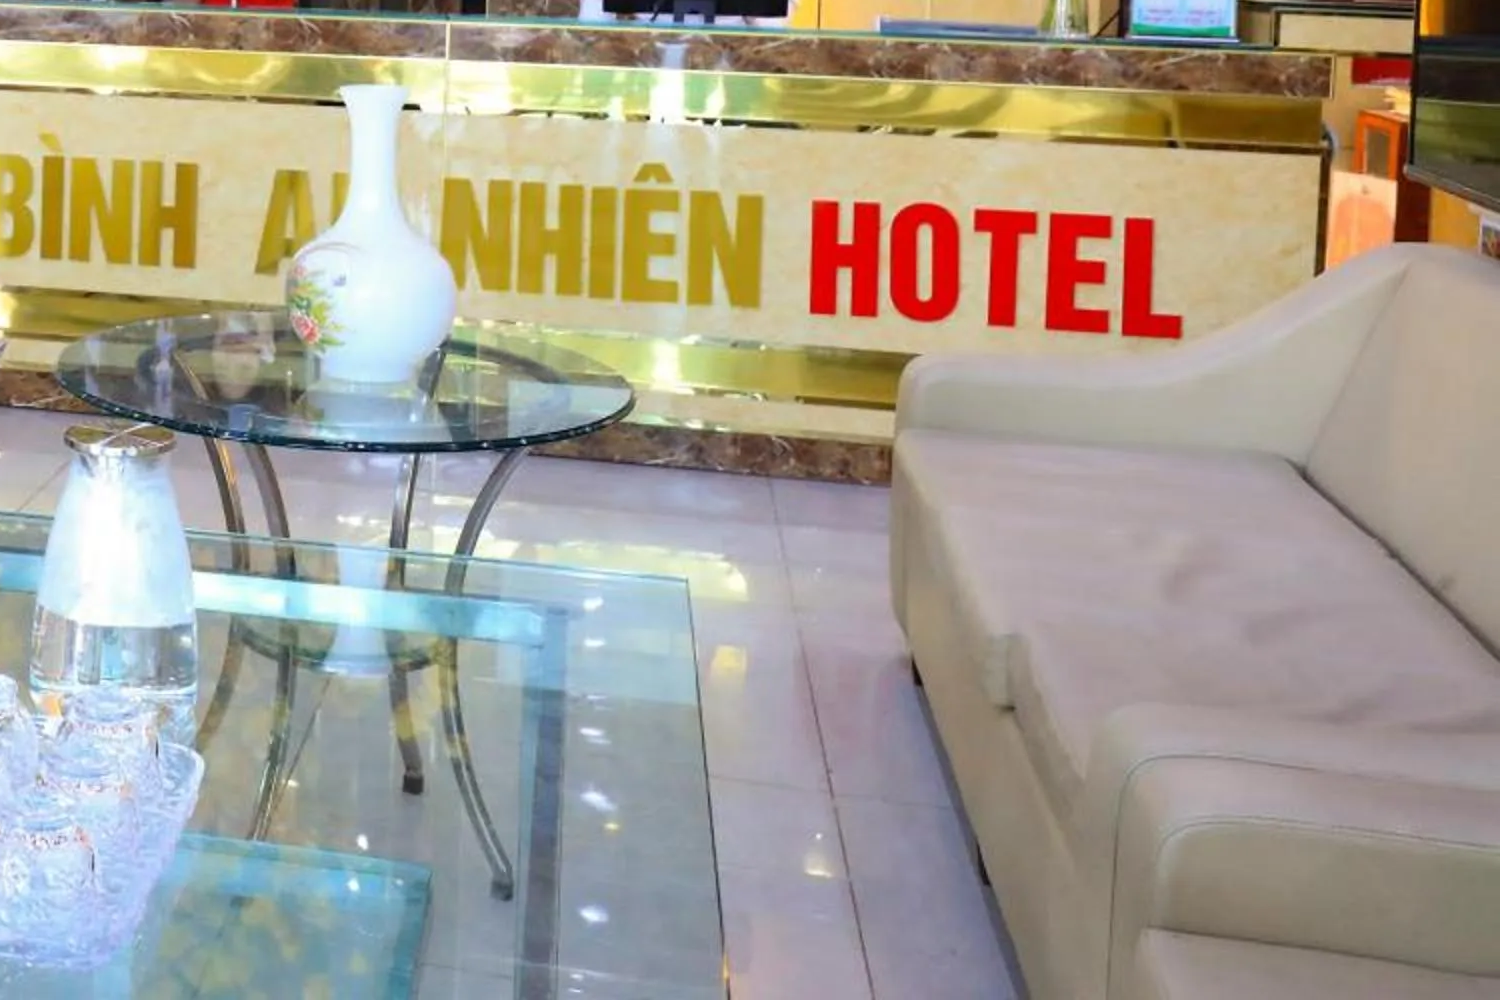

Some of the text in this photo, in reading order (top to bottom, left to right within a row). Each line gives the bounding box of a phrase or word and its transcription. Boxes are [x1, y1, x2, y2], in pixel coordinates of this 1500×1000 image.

[254, 169, 350, 276] A
[439, 162, 764, 309] NHIÊN
[809, 200, 1183, 339] HOTEL
